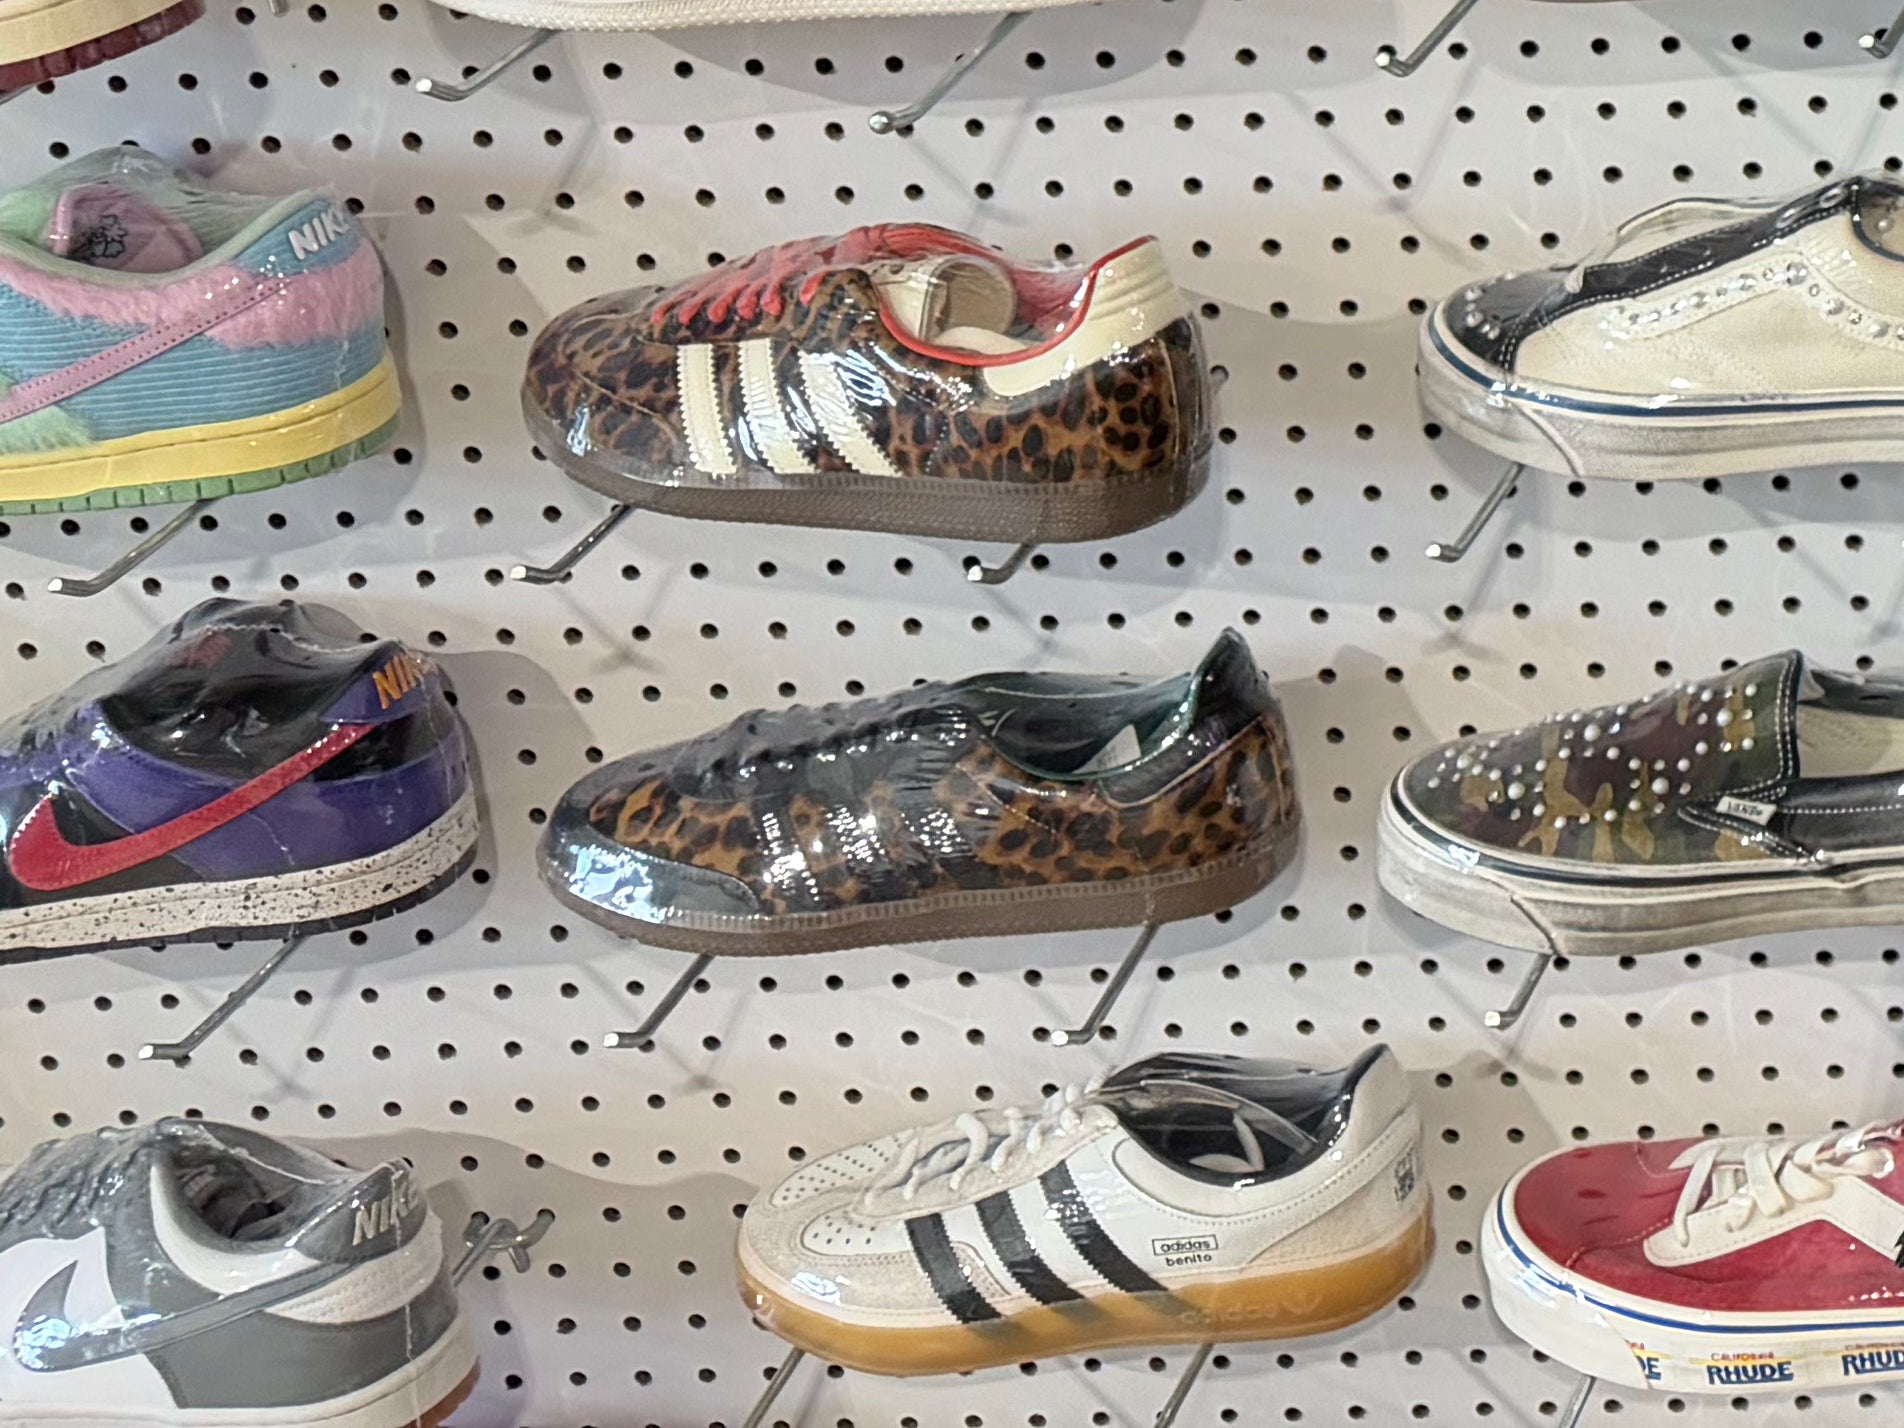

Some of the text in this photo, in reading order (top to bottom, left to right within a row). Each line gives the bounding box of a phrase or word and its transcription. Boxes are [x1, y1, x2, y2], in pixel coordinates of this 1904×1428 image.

[1160, 1239, 1211, 1253] adidas
[1165, 1253, 1213, 1267] benito
[1705, 1360, 1796, 1386] RHUDE
